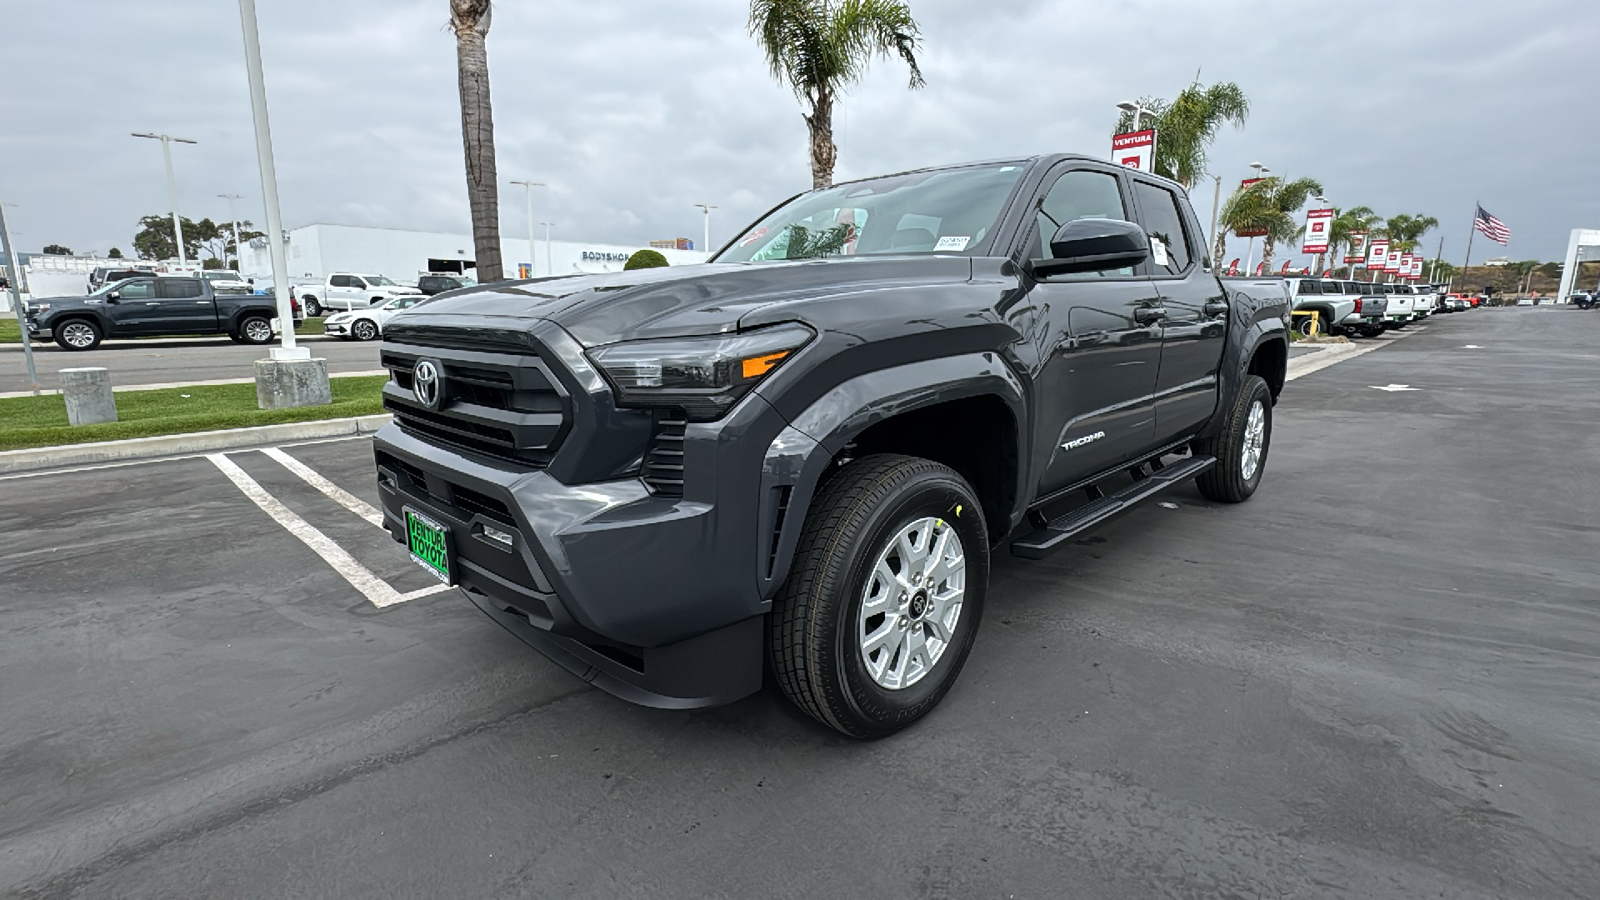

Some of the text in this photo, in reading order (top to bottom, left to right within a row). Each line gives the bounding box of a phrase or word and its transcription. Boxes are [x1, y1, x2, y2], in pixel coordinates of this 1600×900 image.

[1114, 134, 1152, 146] VENTURA
[1060, 430, 1106, 451] TACOMA
[409, 517, 446, 551] VENTUR
[413, 534, 448, 569] TOYOTA
